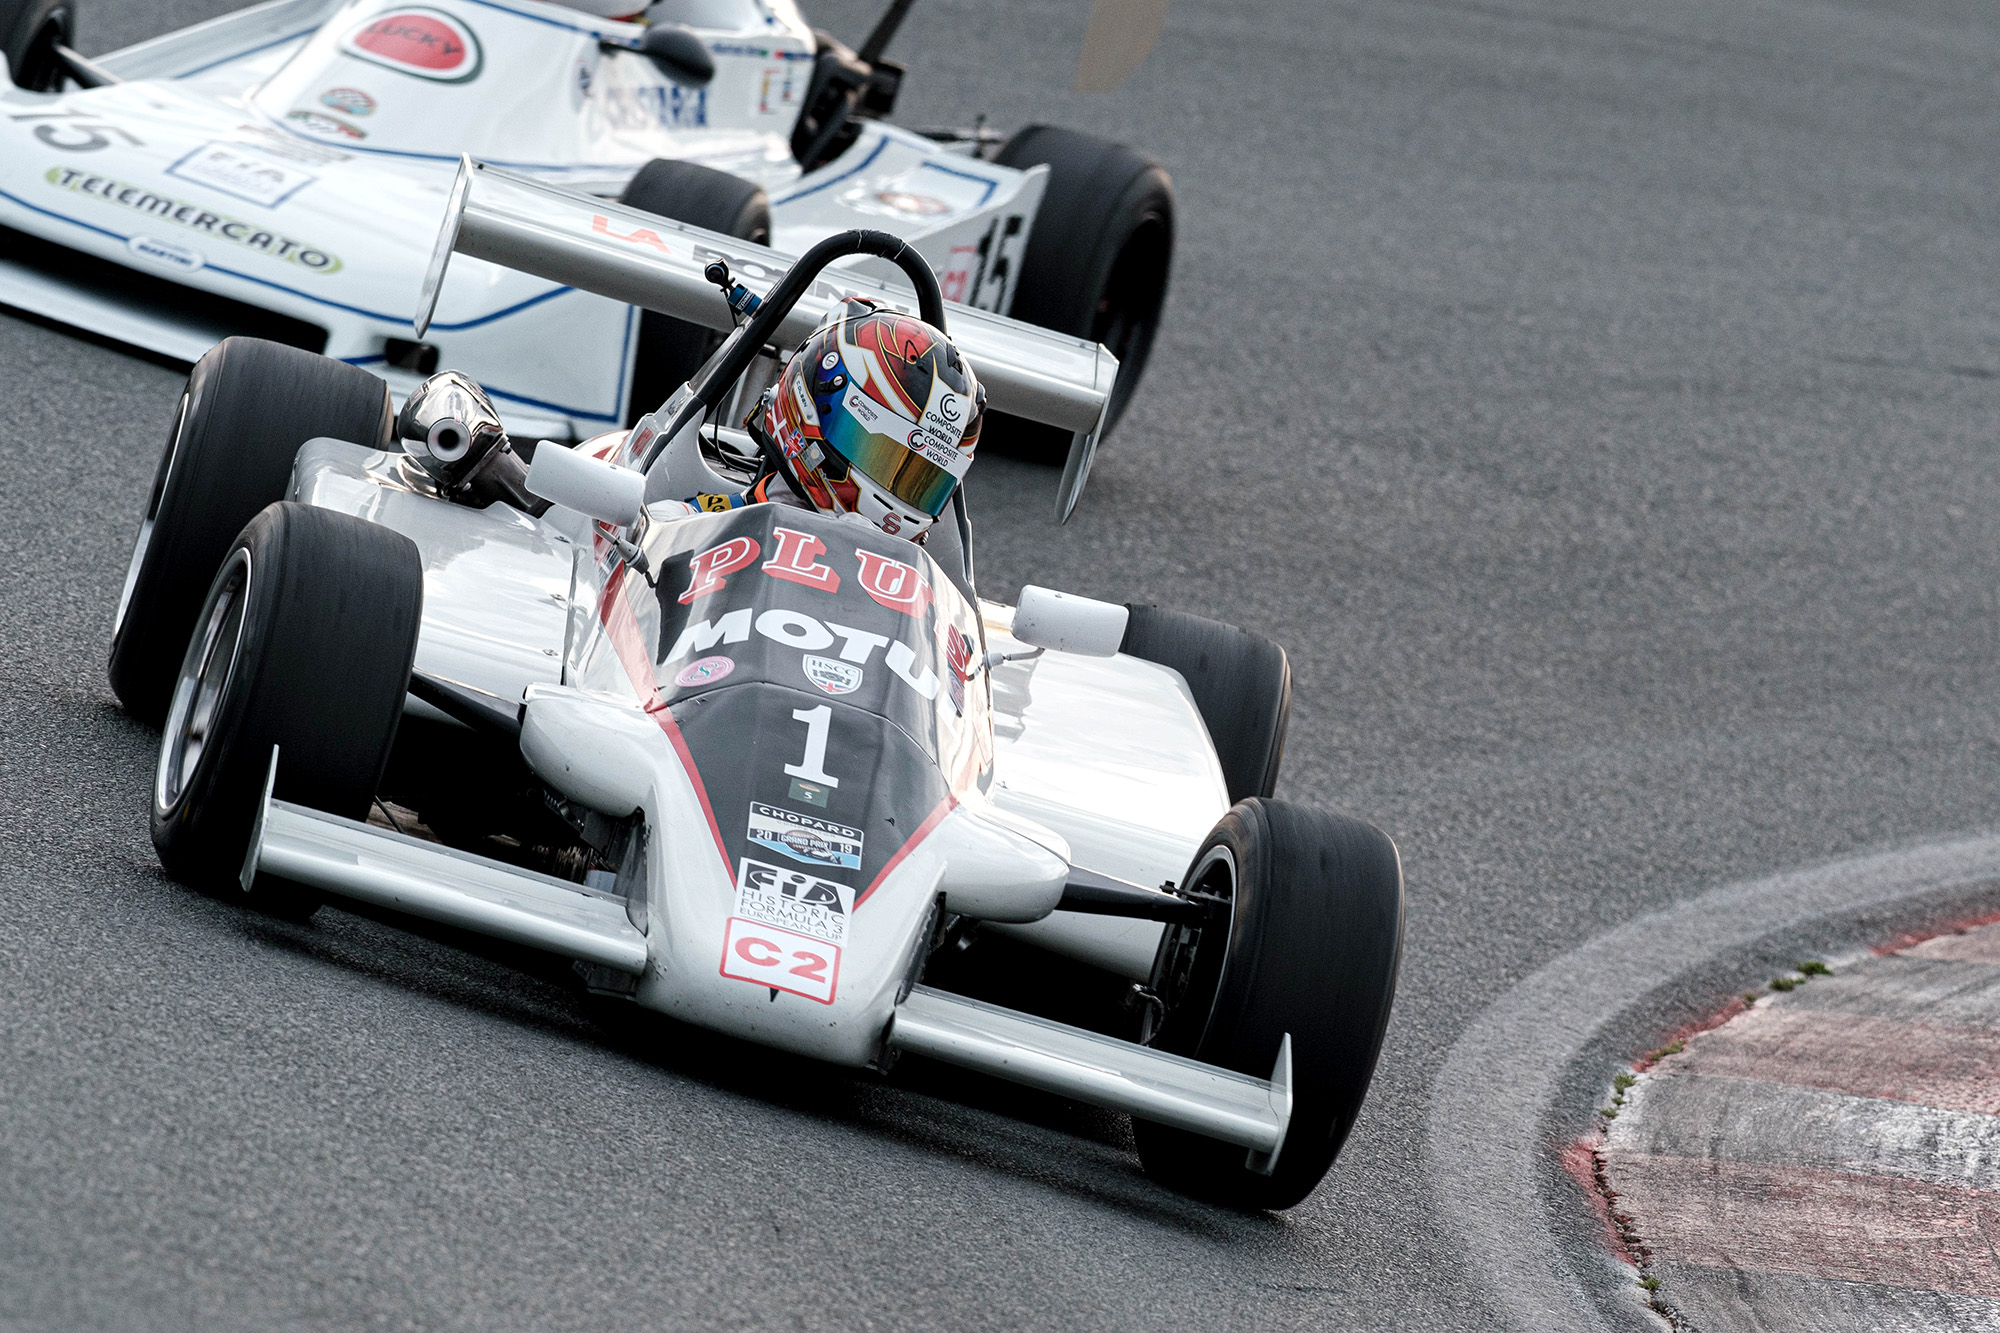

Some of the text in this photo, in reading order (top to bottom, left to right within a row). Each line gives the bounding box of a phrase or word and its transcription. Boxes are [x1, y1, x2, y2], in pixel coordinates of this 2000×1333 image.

[366, 22, 461, 55] LUCKY
[59, 168, 330, 268] TELEMERCATO
[592, 214, 672, 255] LA
[925, 411, 962, 439] COMPOSITE
[928, 425, 953, 445] WORLD
[924, 435, 959, 461] COMPOSITE
[926, 448, 949, 467] WORLD
[812, 659, 857, 676] HSCC
[784, 704, 839, 788] 1
[759, 806, 855, 837] CHOPARD
[756, 829, 773, 841] 20
[780, 834, 809, 846] GRAND
[809, 838, 829, 850] PRIX
[840, 843, 853, 854] 19
[744, 862, 845, 914] FIA
[741, 898, 828, 930] FORMULA
[742, 888, 845, 925] HISTORIC
[740, 906, 843, 941] EUROPEAN CUP
[734, 936, 828, 984] C2
